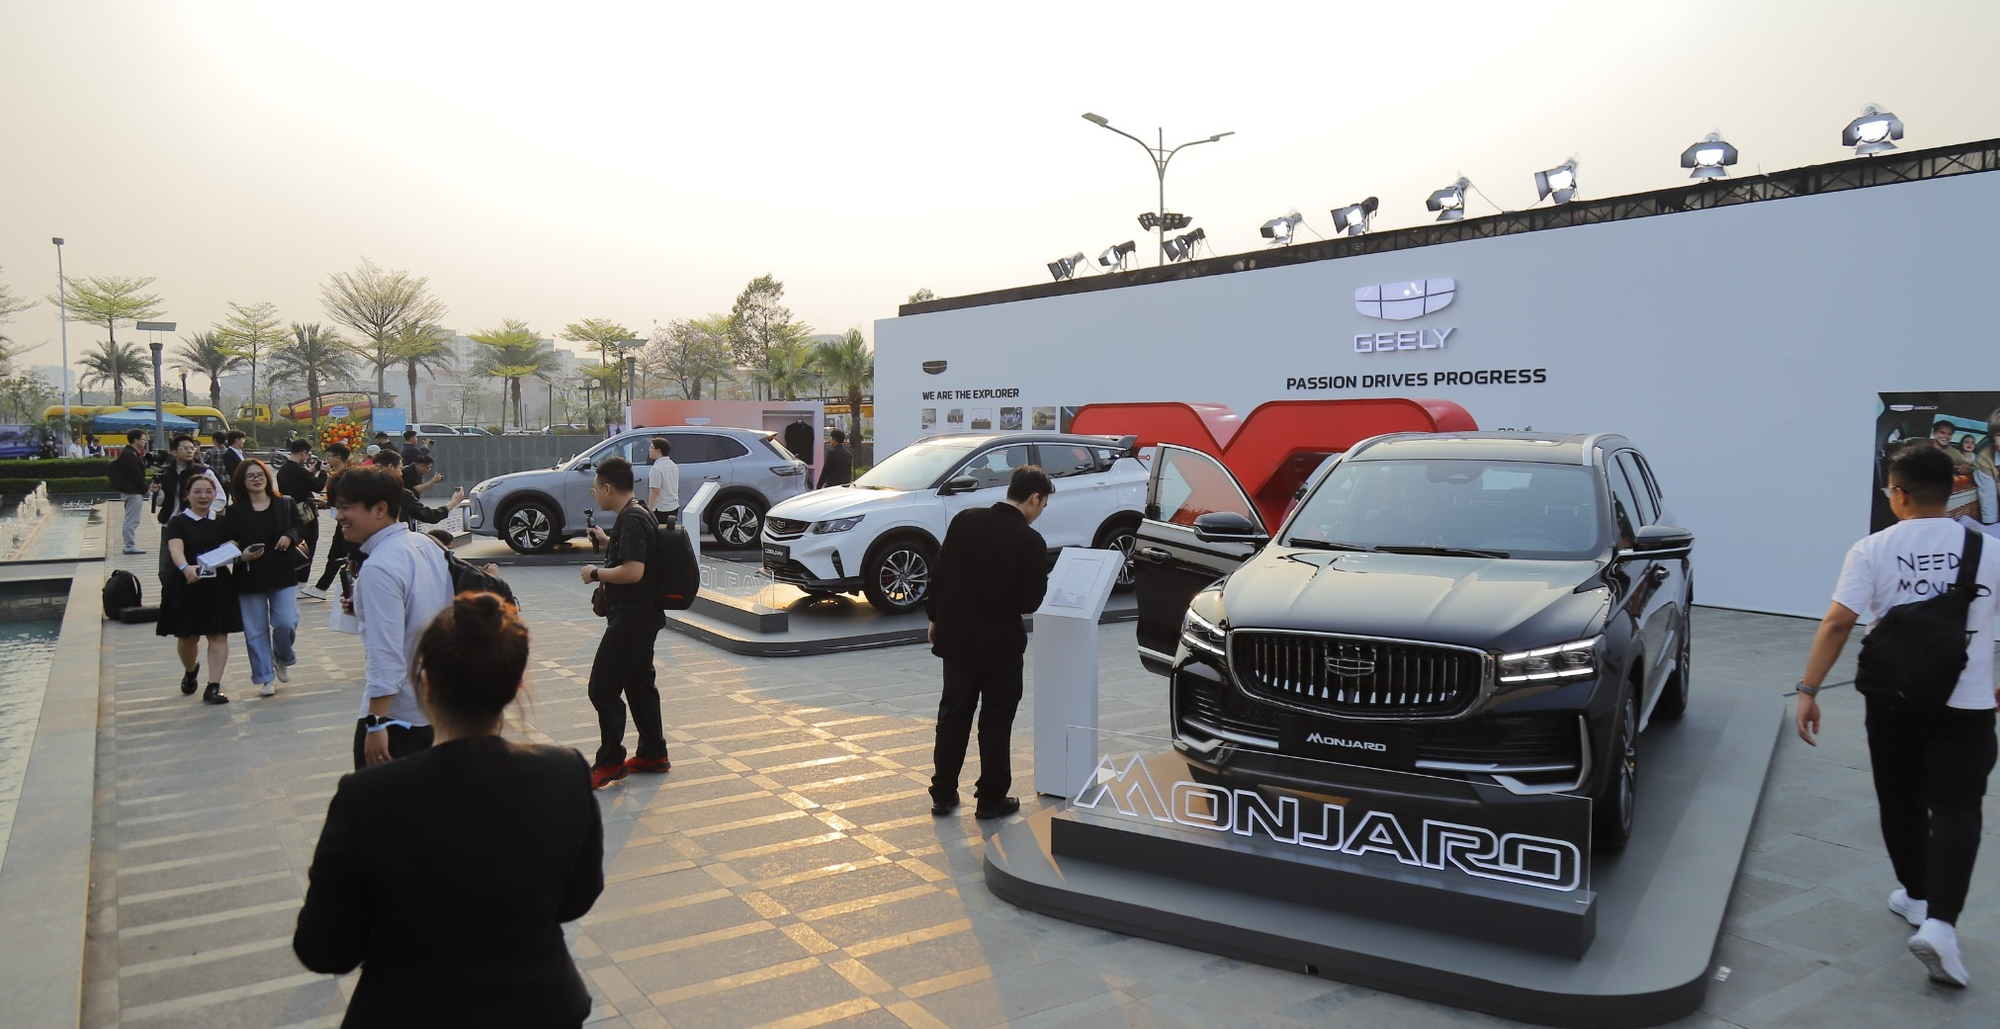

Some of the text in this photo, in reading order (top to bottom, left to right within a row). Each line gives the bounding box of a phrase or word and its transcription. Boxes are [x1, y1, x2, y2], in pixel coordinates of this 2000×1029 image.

[1353, 327, 1457, 353] GEELY
[1286, 368, 1547, 390] PASSION DRIVES PROGRESS
[922, 388, 1020, 401] WE ARE THE EXPLORER
[1897, 552, 1962, 577] NEED
[1306, 732, 1388, 752] MONJARO
[1072, 752, 1581, 893] MONJARO
